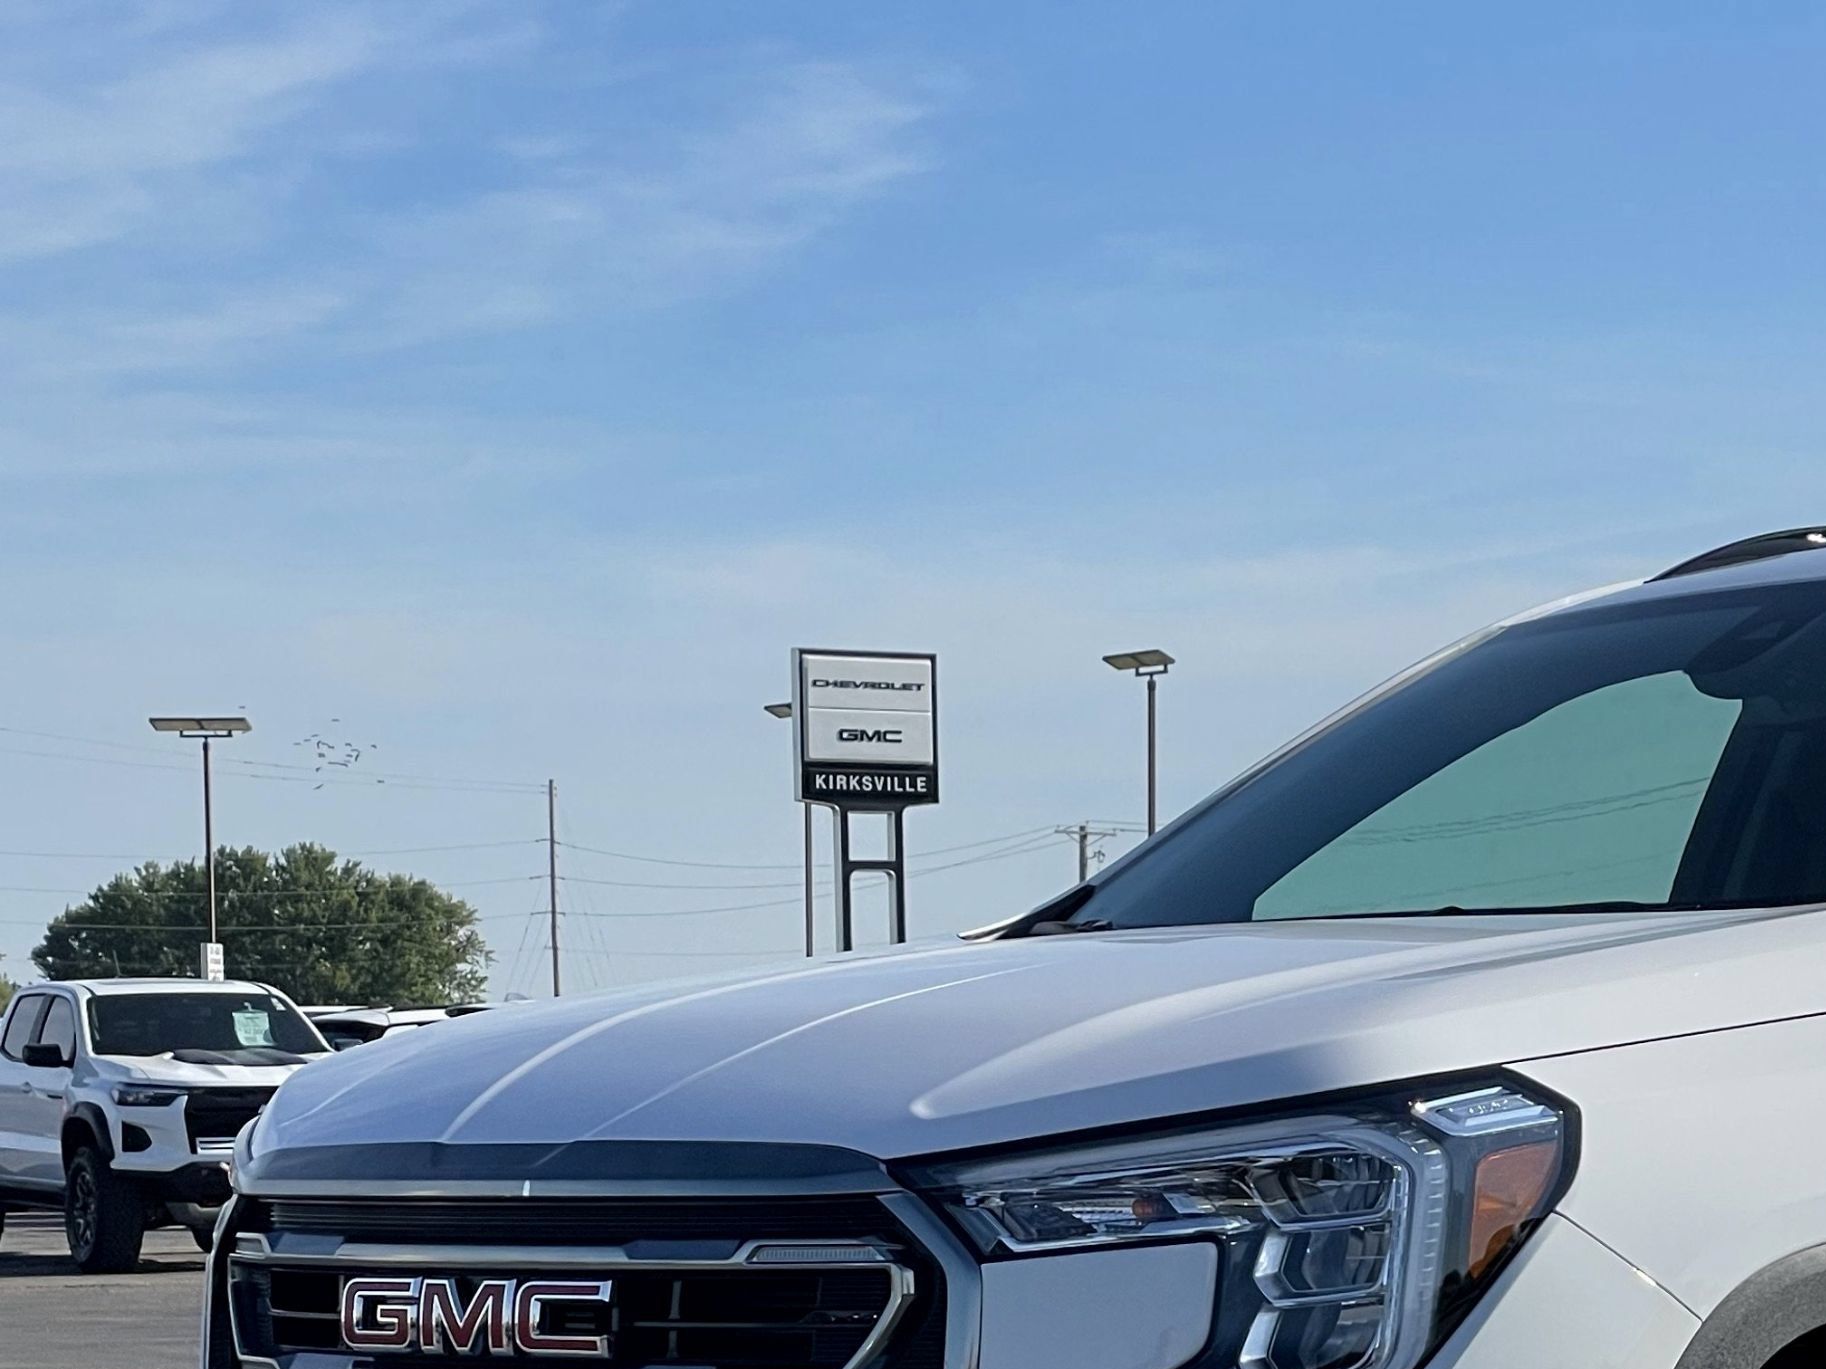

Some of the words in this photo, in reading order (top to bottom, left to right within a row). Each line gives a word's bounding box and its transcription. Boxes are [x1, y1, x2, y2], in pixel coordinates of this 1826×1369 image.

[811, 679, 925, 691] CHEVROLET
[837, 728, 903, 743] GMC
[815, 774, 928, 792] KIRKSVILLE
[341, 1276, 615, 1359] GMC
